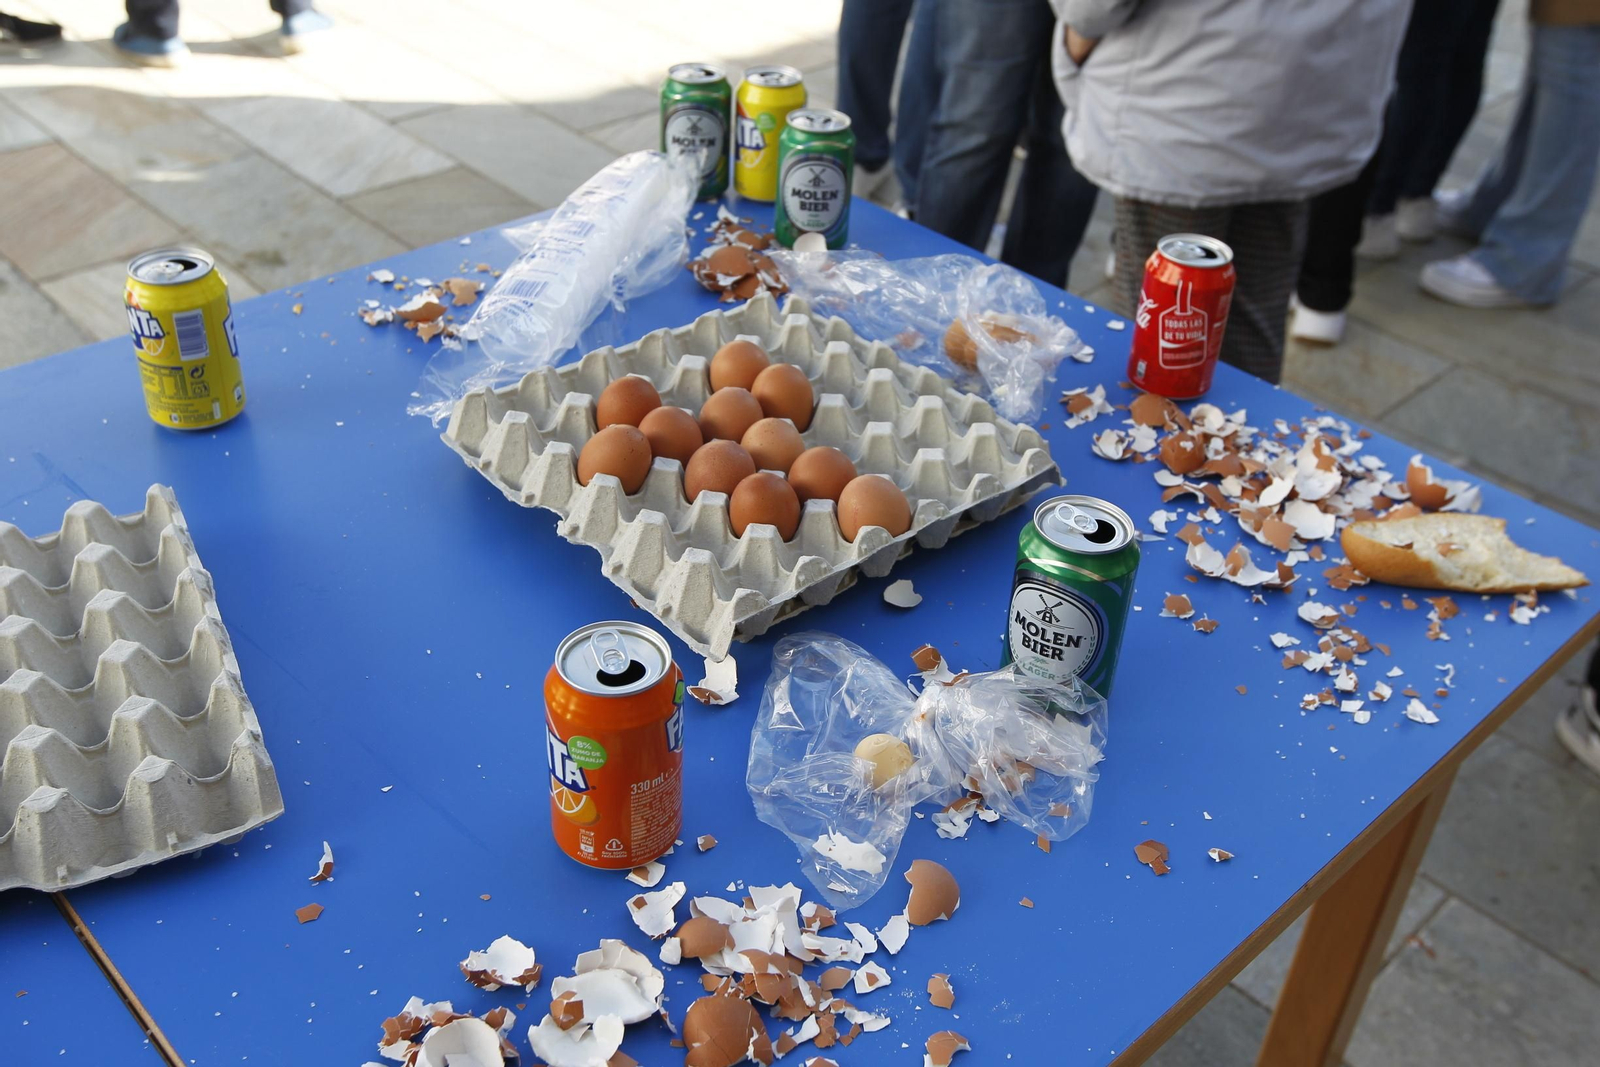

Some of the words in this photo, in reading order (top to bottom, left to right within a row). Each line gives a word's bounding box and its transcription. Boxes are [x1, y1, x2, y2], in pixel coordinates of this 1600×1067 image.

[791, 187, 838, 201] MOLEN
[799, 200, 830, 212] BIER
[1164, 319, 1188, 329] TODAS
[1189, 319, 1203, 328] LAS
[1015, 610, 1083, 649] MOLEN
[1022, 632, 1065, 662] BIER
[1022, 662, 1056, 681] LAGER
[630, 779, 650, 795] 330
[652, 772, 664, 788] ml
